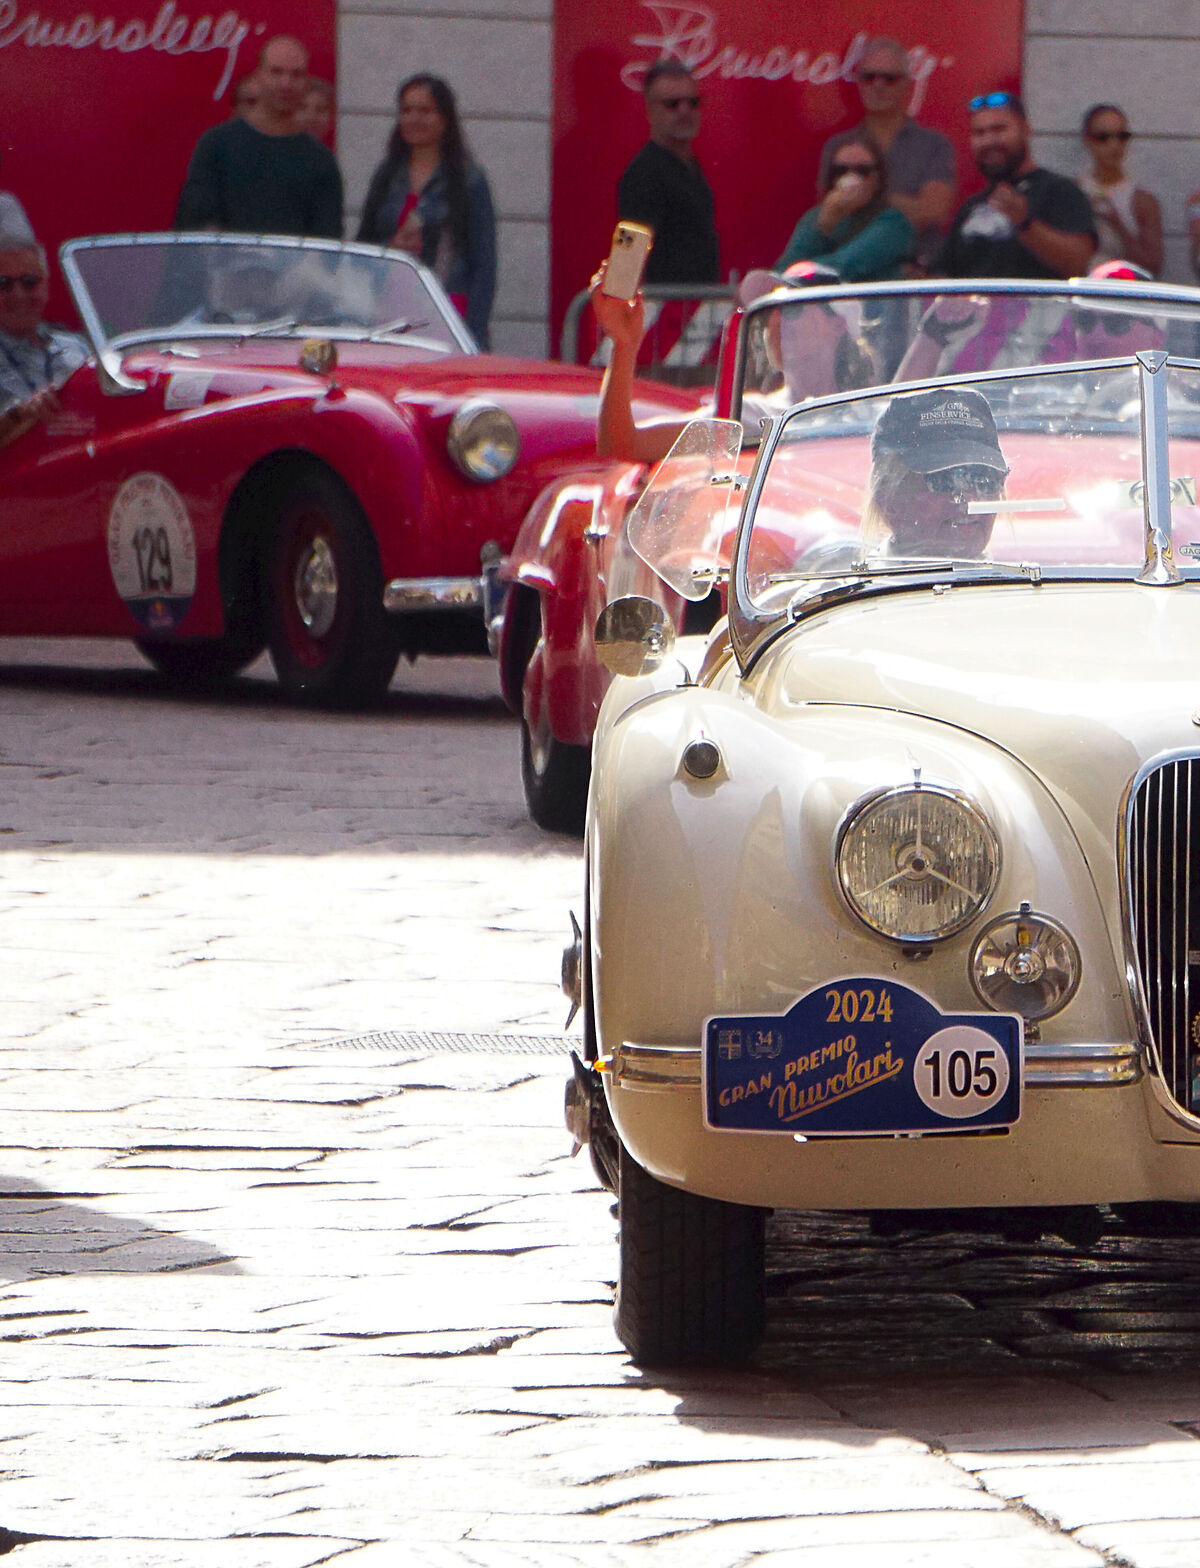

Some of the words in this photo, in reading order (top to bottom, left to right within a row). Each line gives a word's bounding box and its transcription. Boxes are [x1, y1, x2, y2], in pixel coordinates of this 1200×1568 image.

[132, 526, 173, 592] 129
[826, 988, 893, 1023] 2024
[756, 1031, 773, 1046] 34
[719, 1072, 772, 1107] GRAN
[785, 1035, 857, 1081] PREMIO
[769, 1041, 904, 1120] Nuvolari
[924, 1050, 997, 1098] 105
